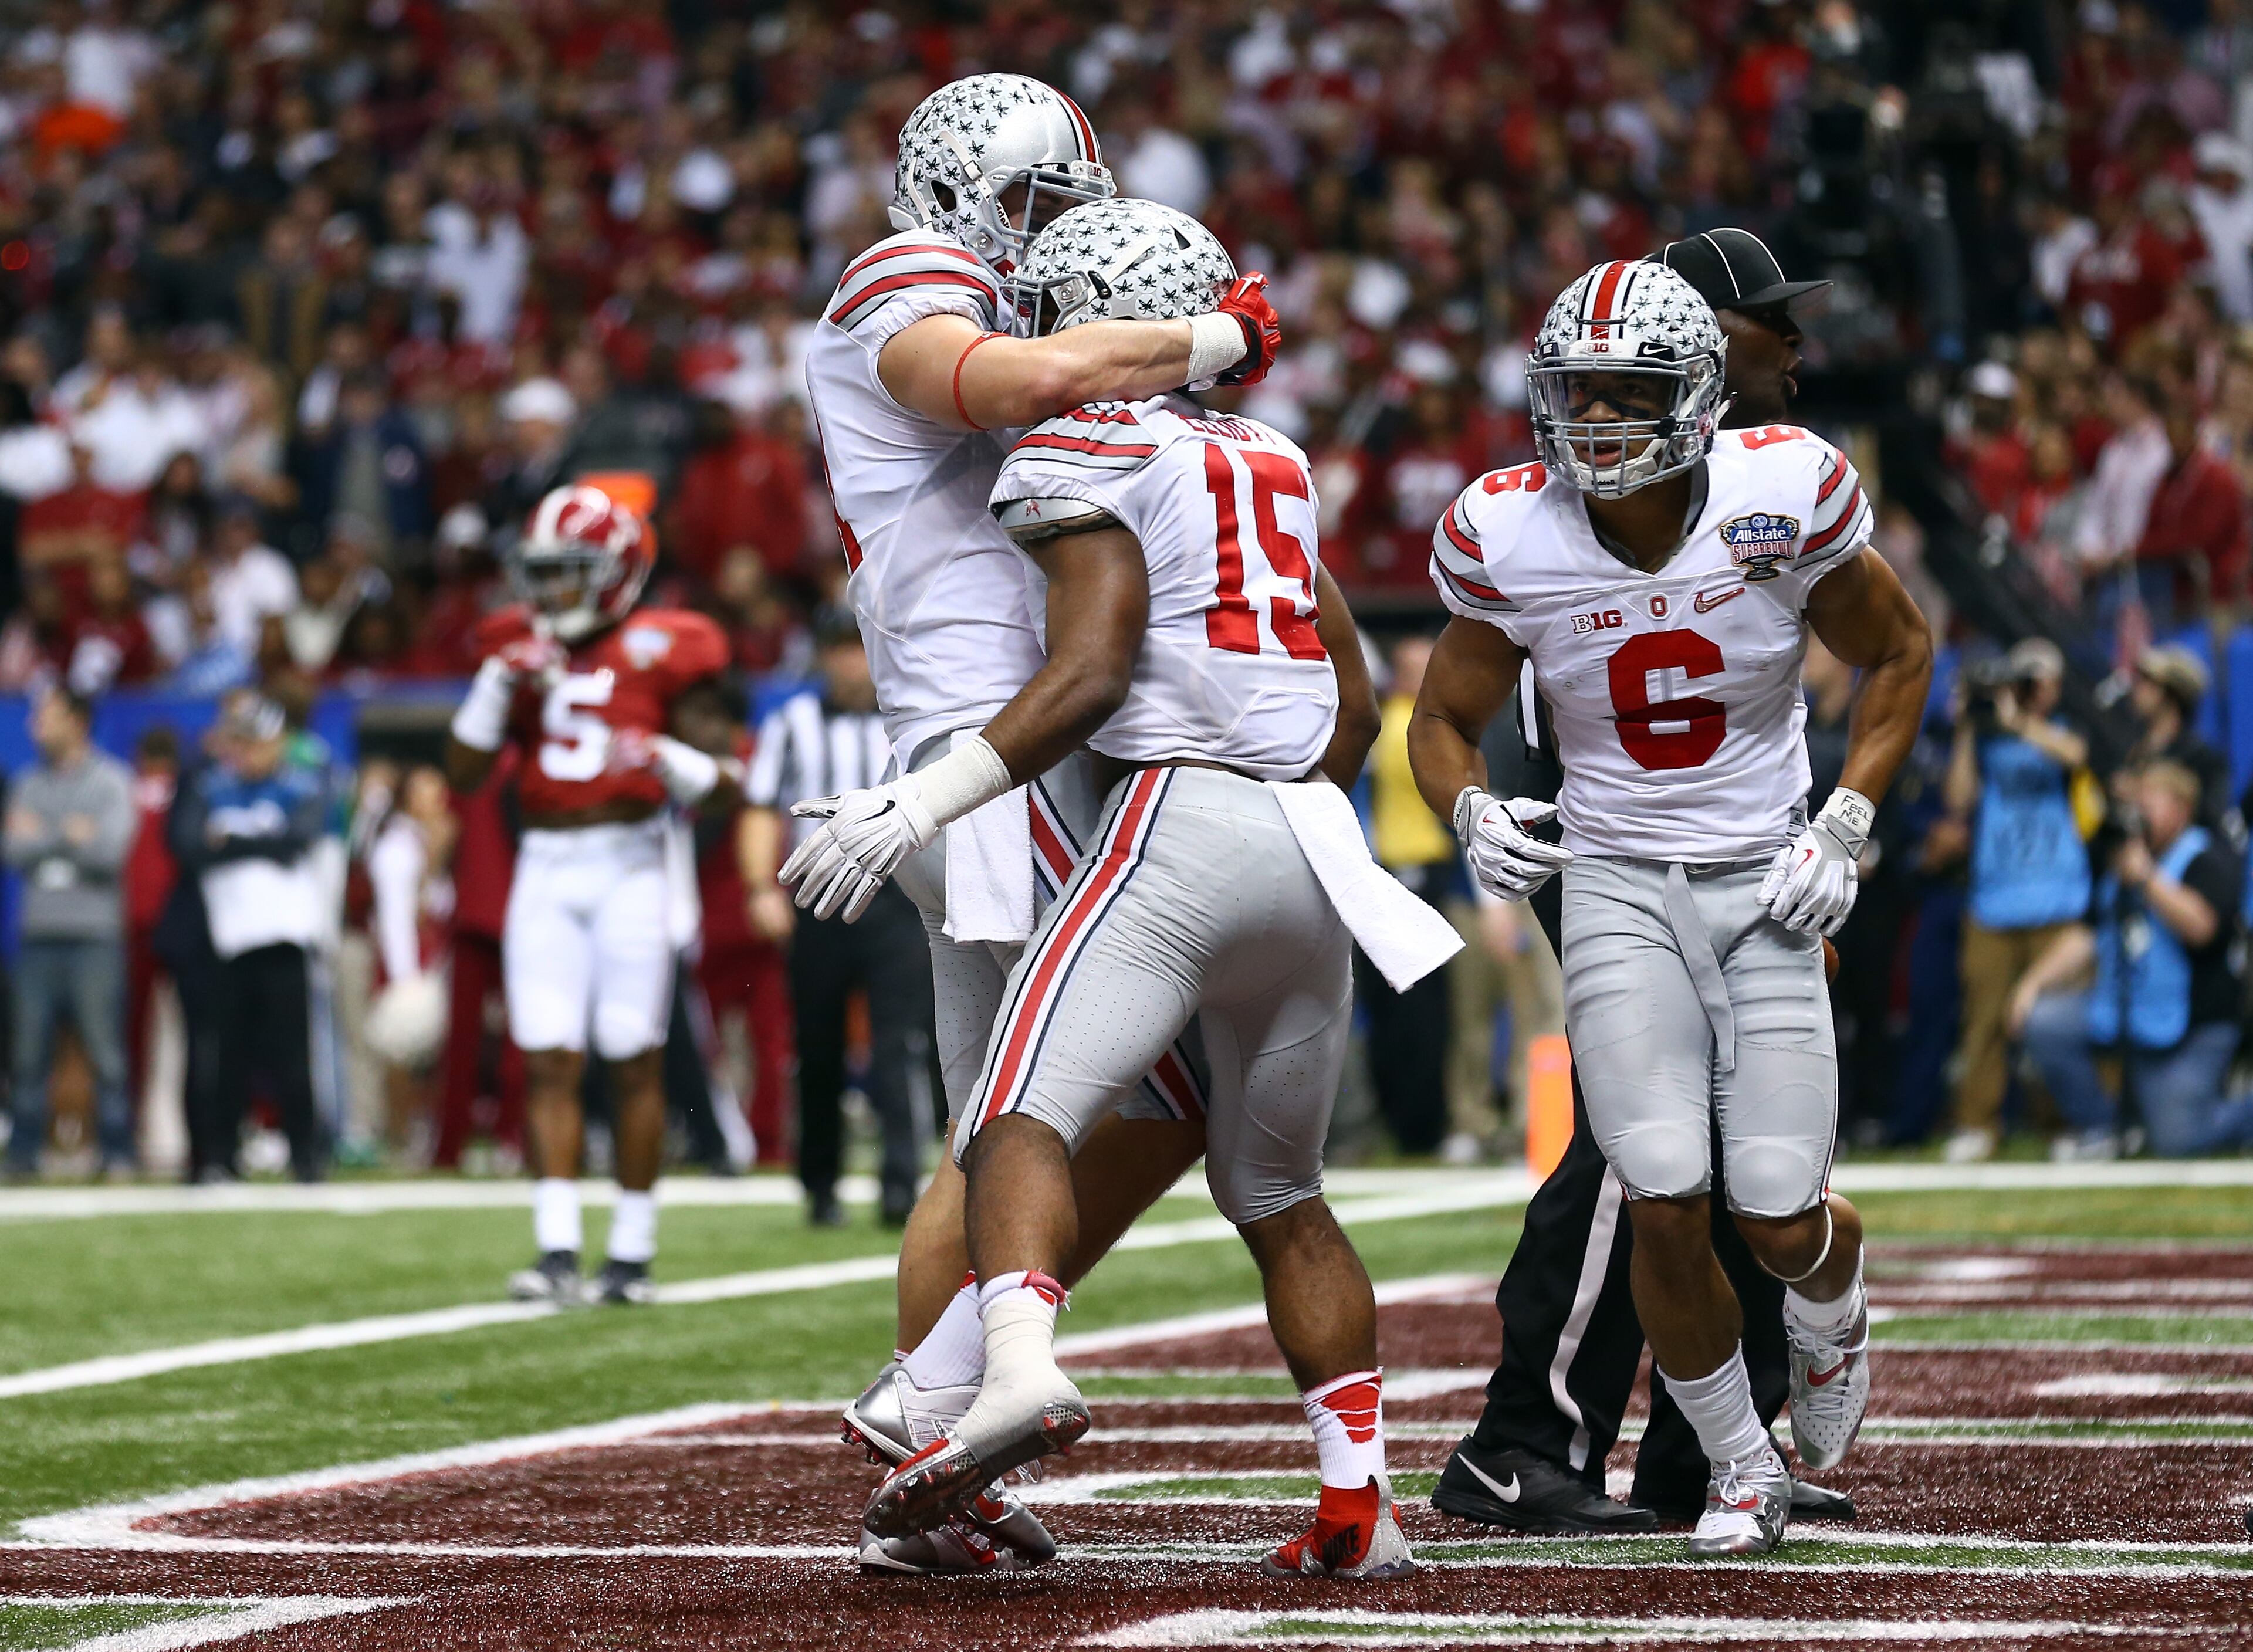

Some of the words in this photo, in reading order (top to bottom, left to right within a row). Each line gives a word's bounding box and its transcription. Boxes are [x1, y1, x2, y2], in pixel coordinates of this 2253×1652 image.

[1204, 441, 1327, 661] 15
[1733, 527, 1787, 543] Allstate
[1608, 628, 1726, 770] 6
[540, 672, 614, 781] 5
[1838, 809, 1859, 826] ME
[1840, 795, 1870, 822] FEEL
[1322, 1523, 1360, 1575] NIKE
